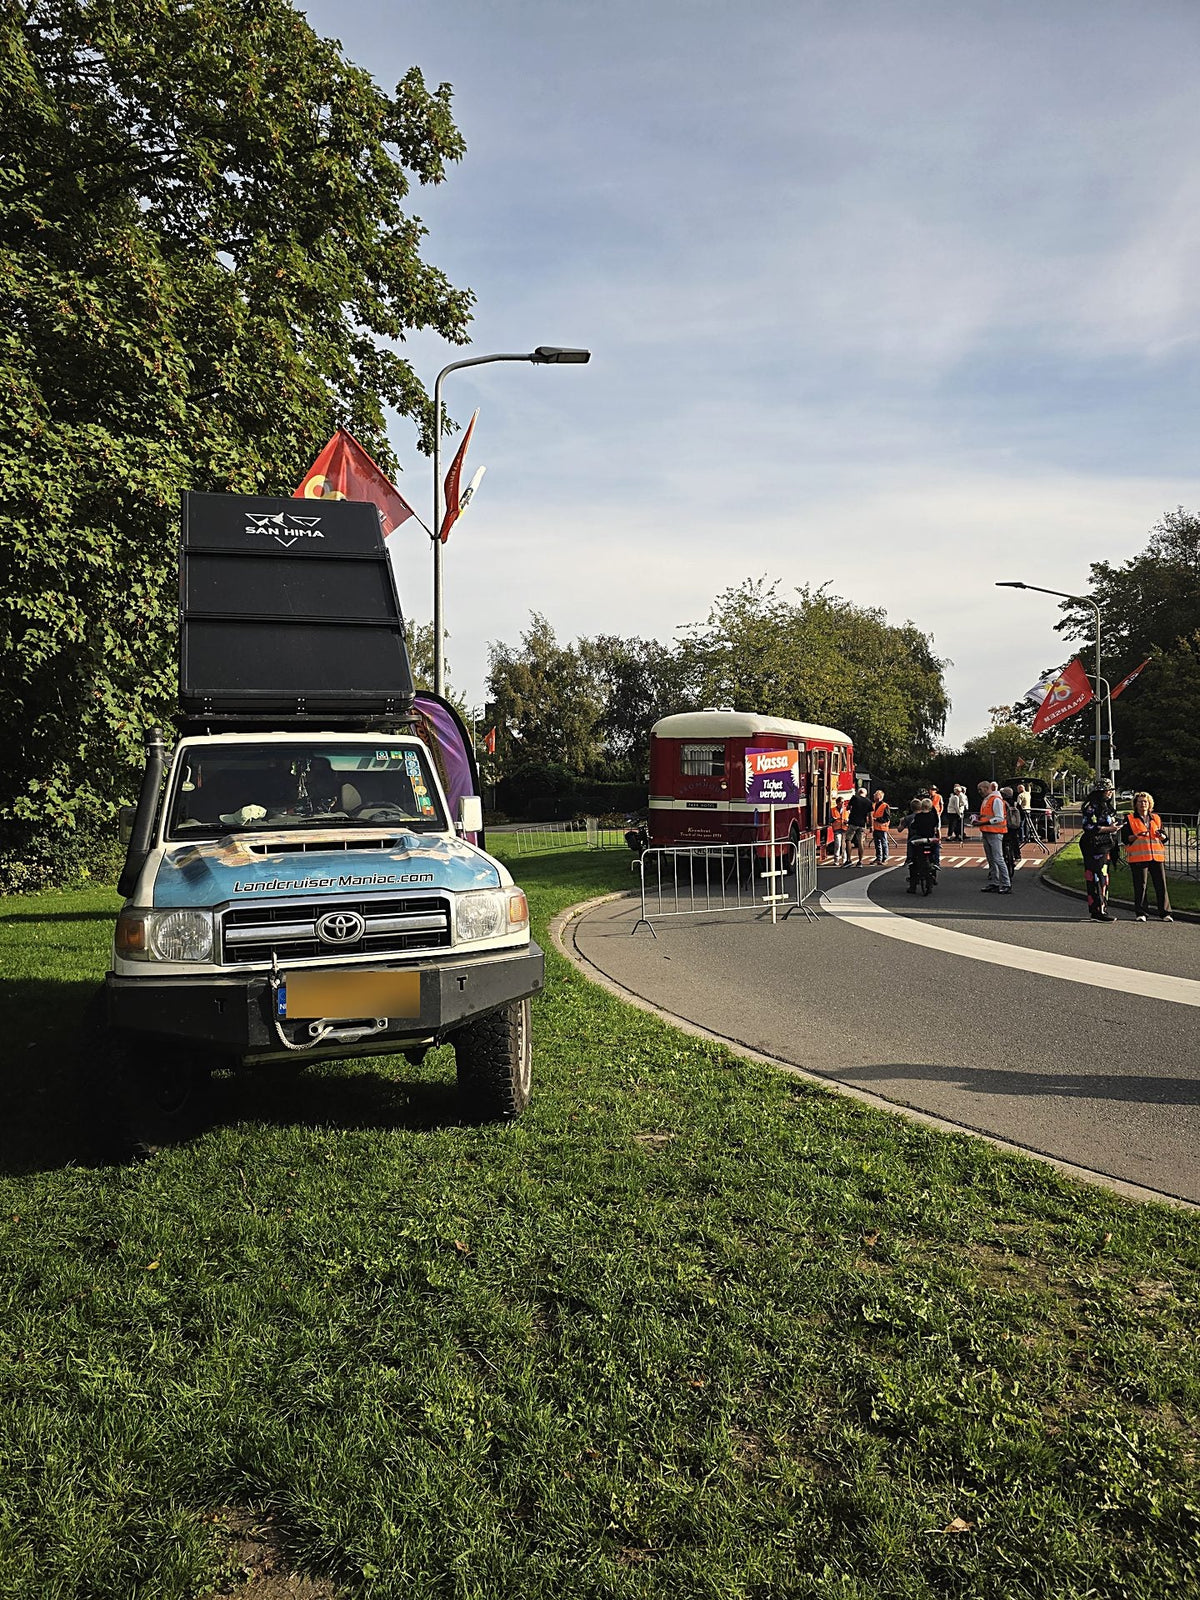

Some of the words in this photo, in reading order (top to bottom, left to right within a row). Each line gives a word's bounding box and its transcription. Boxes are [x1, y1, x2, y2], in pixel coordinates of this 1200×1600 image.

[245, 526, 280, 537] SAN
[285, 528, 325, 538] HIMA
[757, 755, 789, 771] Kassa
[762, 779, 784, 790] Ticket
[760, 788, 787, 801] verkoop
